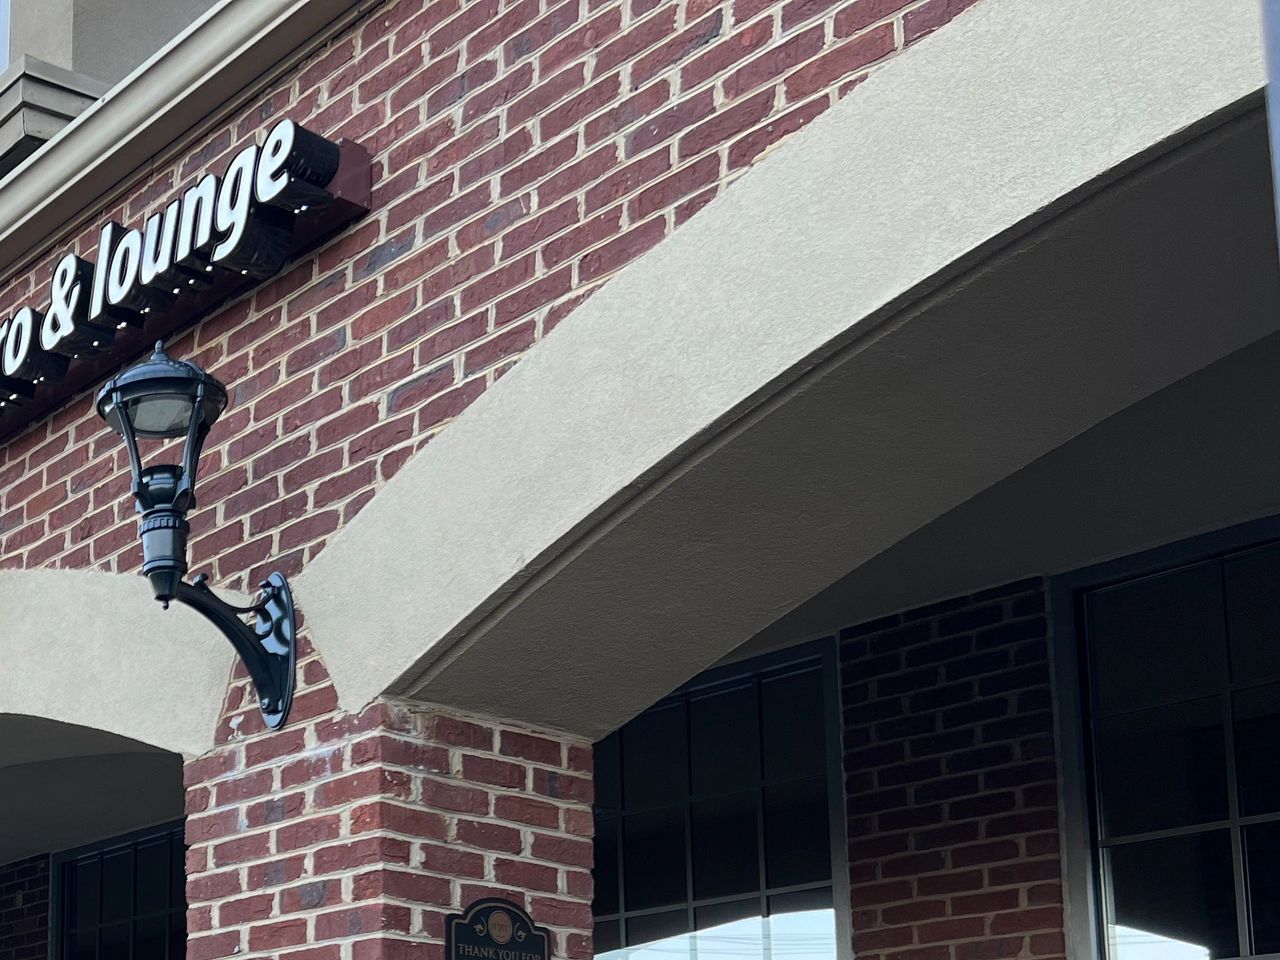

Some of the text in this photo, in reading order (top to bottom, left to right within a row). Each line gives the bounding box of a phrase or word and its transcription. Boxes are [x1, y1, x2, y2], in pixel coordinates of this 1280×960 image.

[40, 253, 81, 350] &
[88, 118, 295, 321] lounge
[457, 943, 495, 958] THANK
